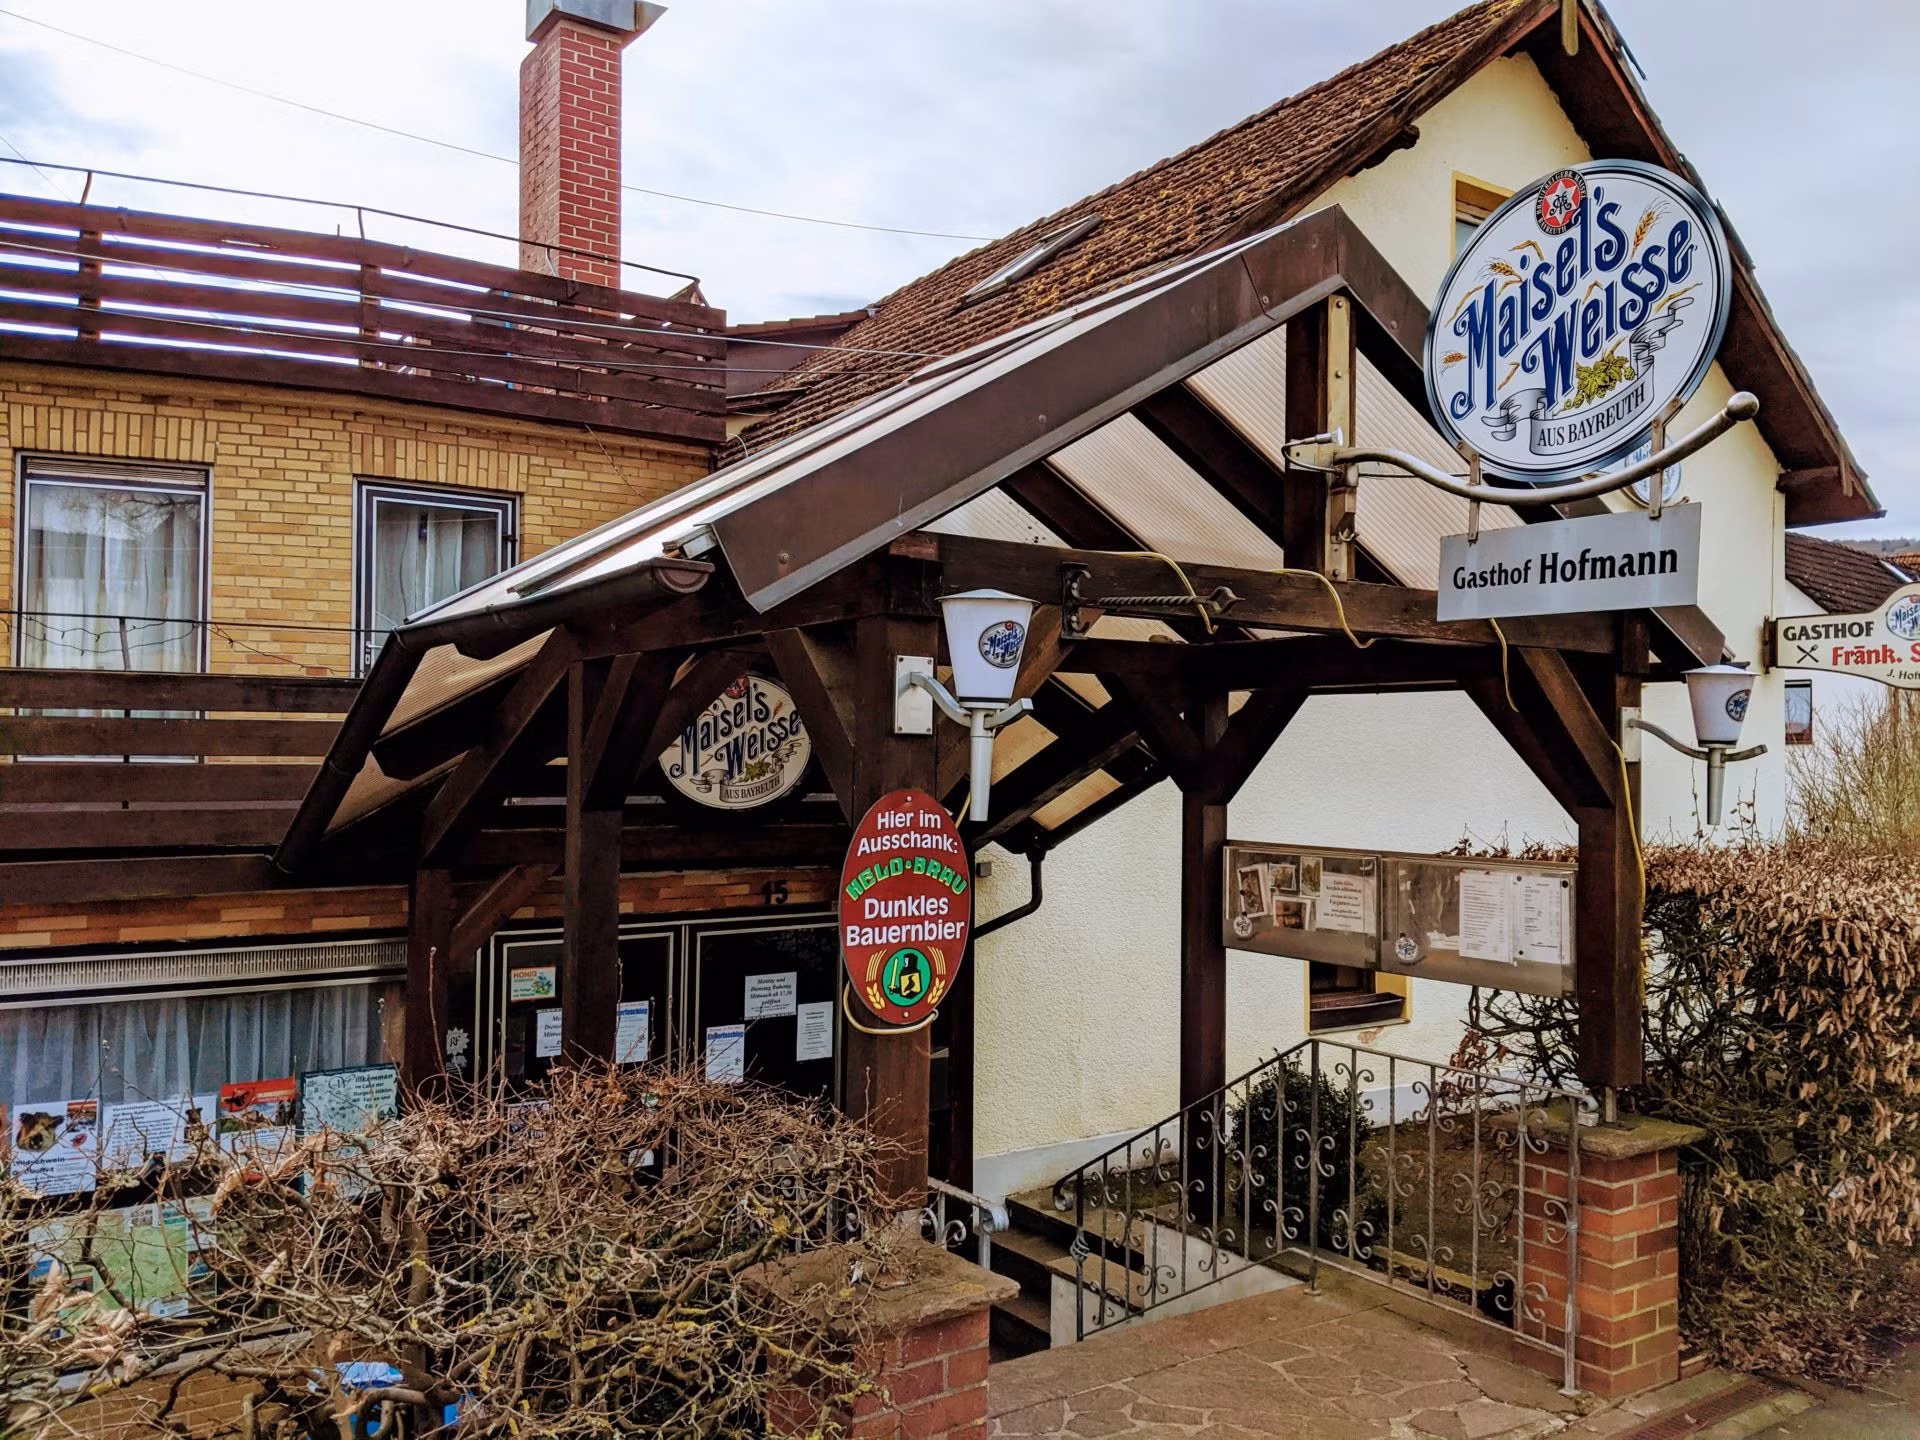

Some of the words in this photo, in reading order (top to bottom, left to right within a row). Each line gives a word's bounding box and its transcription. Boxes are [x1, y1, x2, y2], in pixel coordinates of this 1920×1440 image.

[1450, 186, 1630, 420] Maisel's
[1521, 219, 1697, 413] Weisse
[1537, 425, 1565, 447] AUS
[1568, 382, 1645, 443] BAYREUTH
[1453, 558, 1532, 590] Gasthof
[1539, 548, 1679, 585] Hofmann
[1783, 621, 1875, 642] GASTHOF
[1886, 668, 1895, 678] J.
[669, 682, 771, 779] Maisel's
[714, 709, 802, 781] Weisse
[724, 789, 740, 799] AUS
[741, 778, 780, 799] BAYREUTH
[877, 810, 914, 830] Hier
[919, 810, 941, 829] im
[857, 830, 958, 857] Ausschank:
[762, 879, 789, 905] 15
[864, 895, 949, 920] Dunkles
[846, 919, 965, 947] Bauernbier
[513, 970, 537, 979] HONIG
